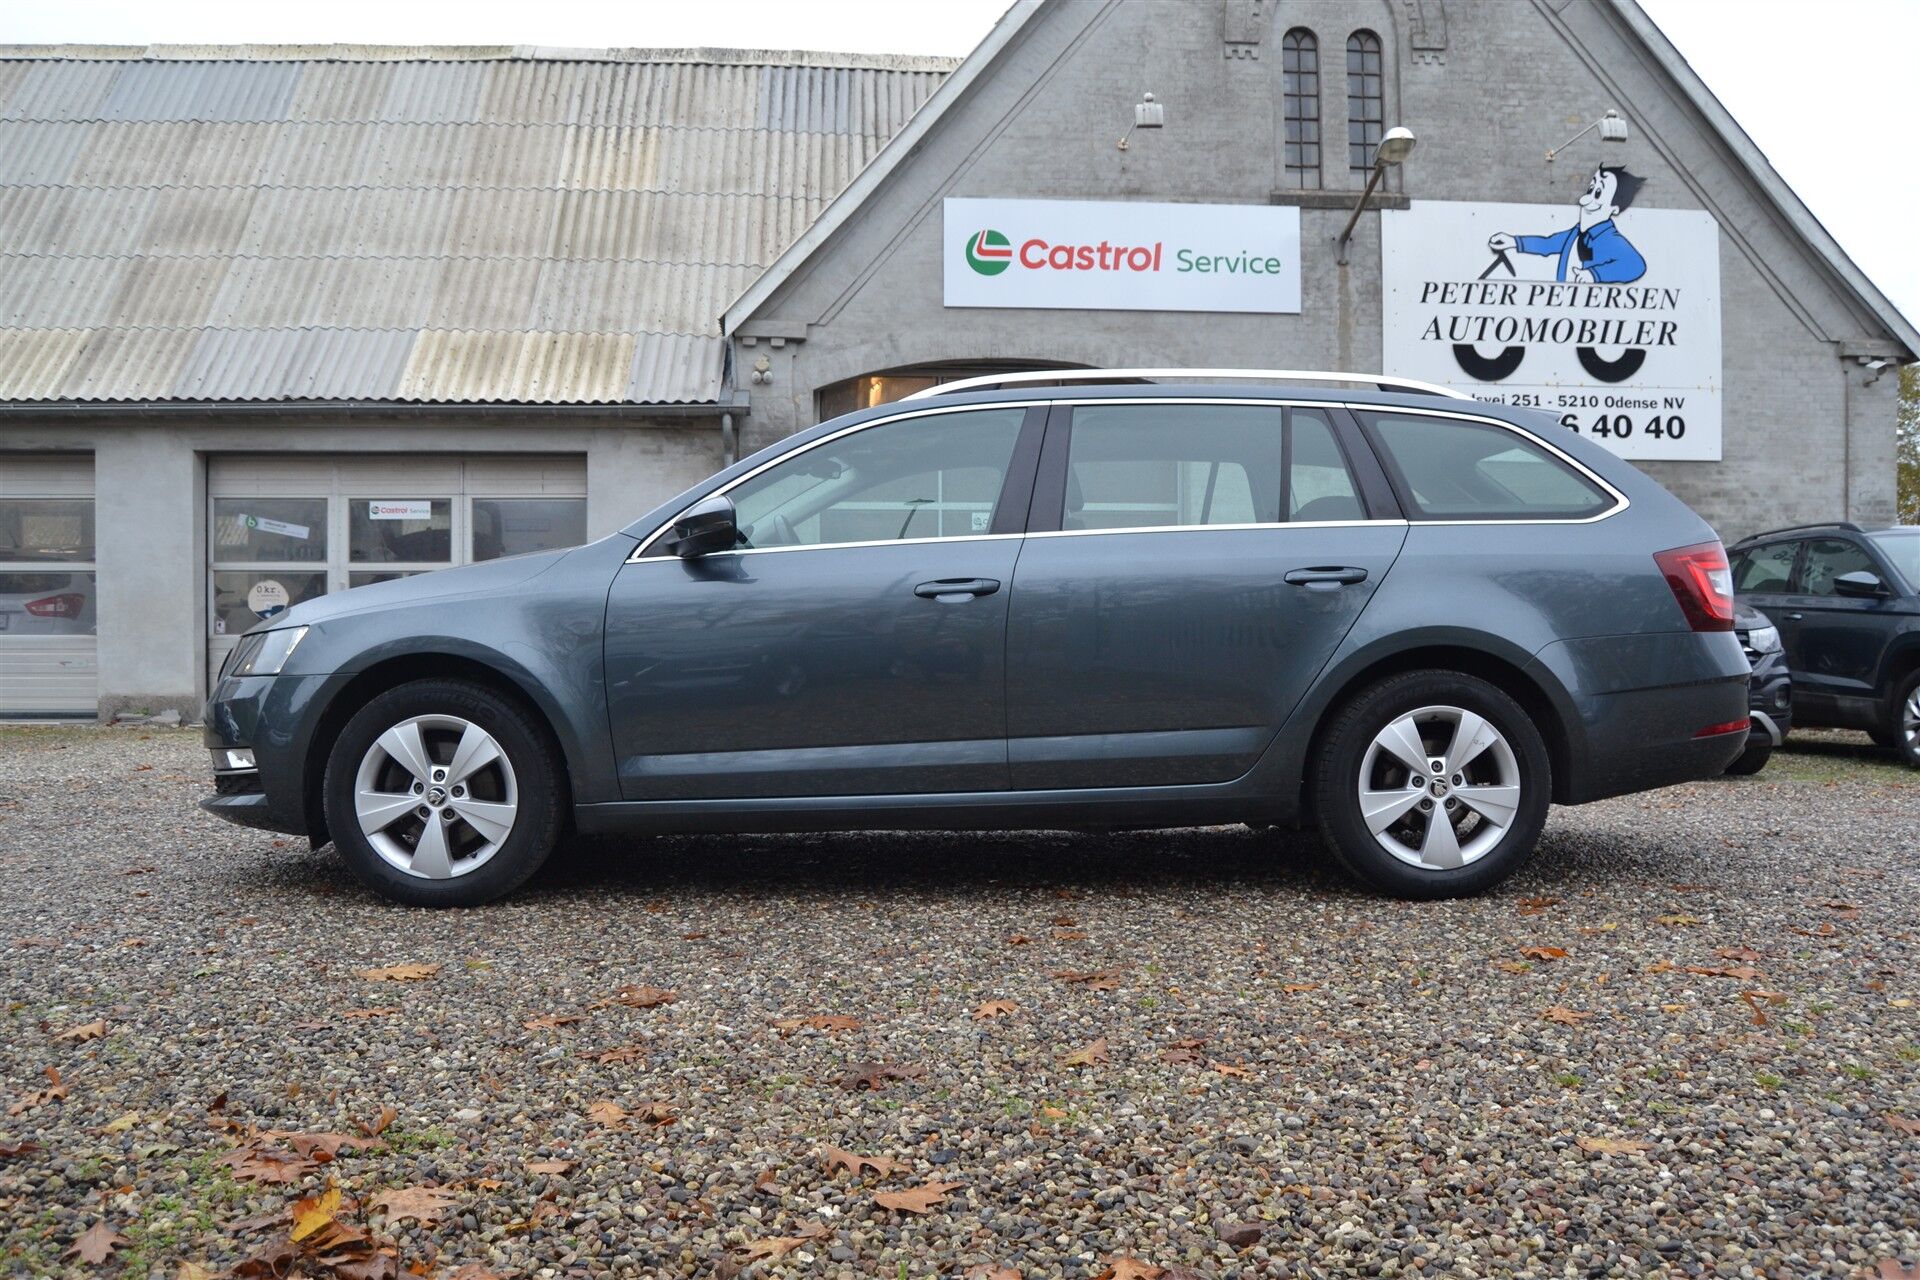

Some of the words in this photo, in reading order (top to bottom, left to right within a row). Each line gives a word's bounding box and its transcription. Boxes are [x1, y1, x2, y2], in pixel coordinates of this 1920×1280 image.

[1019, 238, 1162, 272] Castrol
[1176, 249, 1281, 275] Service
[1420, 281, 1518, 306] PETER
[1526, 284, 1680, 310] PETERSEN
[1421, 315, 1678, 346] AUTOMOBILER
[1511, 393, 1541, 407] 251
[1558, 394, 1599, 408] 5210
[1604, 395, 1658, 409] Odense
[1663, 396, 1685, 410] NV
[1591, 414, 1633, 439] 40
[1644, 415, 1686, 440] 40
[380, 506, 408, 514] Castrol
